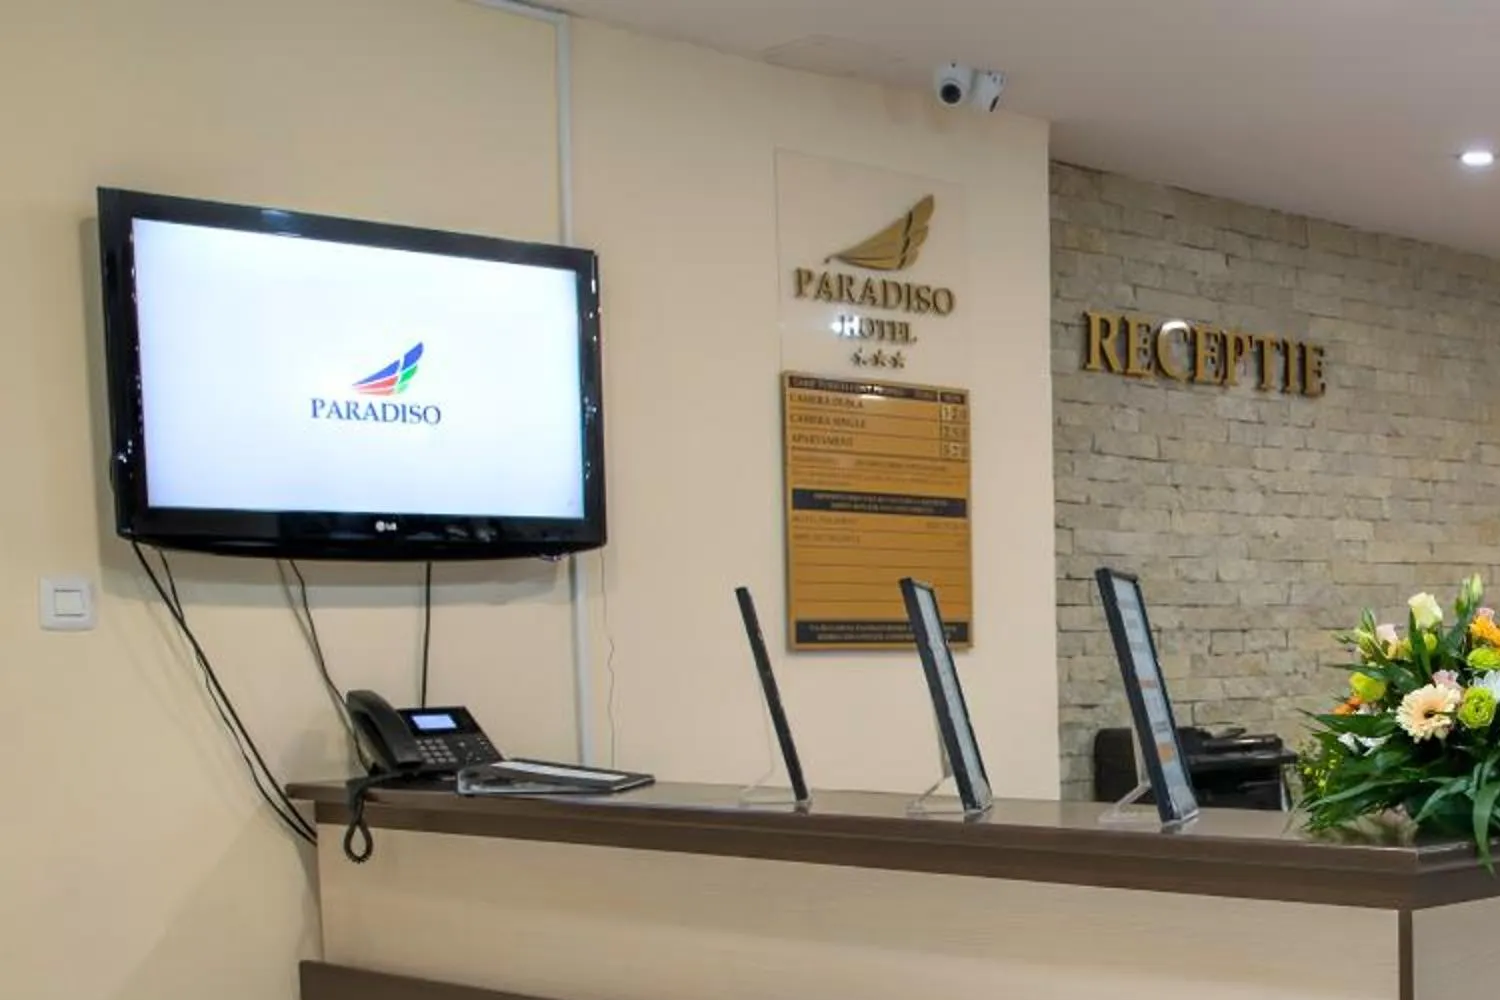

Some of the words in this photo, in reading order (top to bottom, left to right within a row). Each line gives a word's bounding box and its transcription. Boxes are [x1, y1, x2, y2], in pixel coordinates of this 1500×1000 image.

[794, 267, 956, 317] PARADISO
[838, 314, 917, 343] HOTEL
[1083, 311, 1326, 396] RECEPTIE
[310, 397, 442, 426] PARADISO
